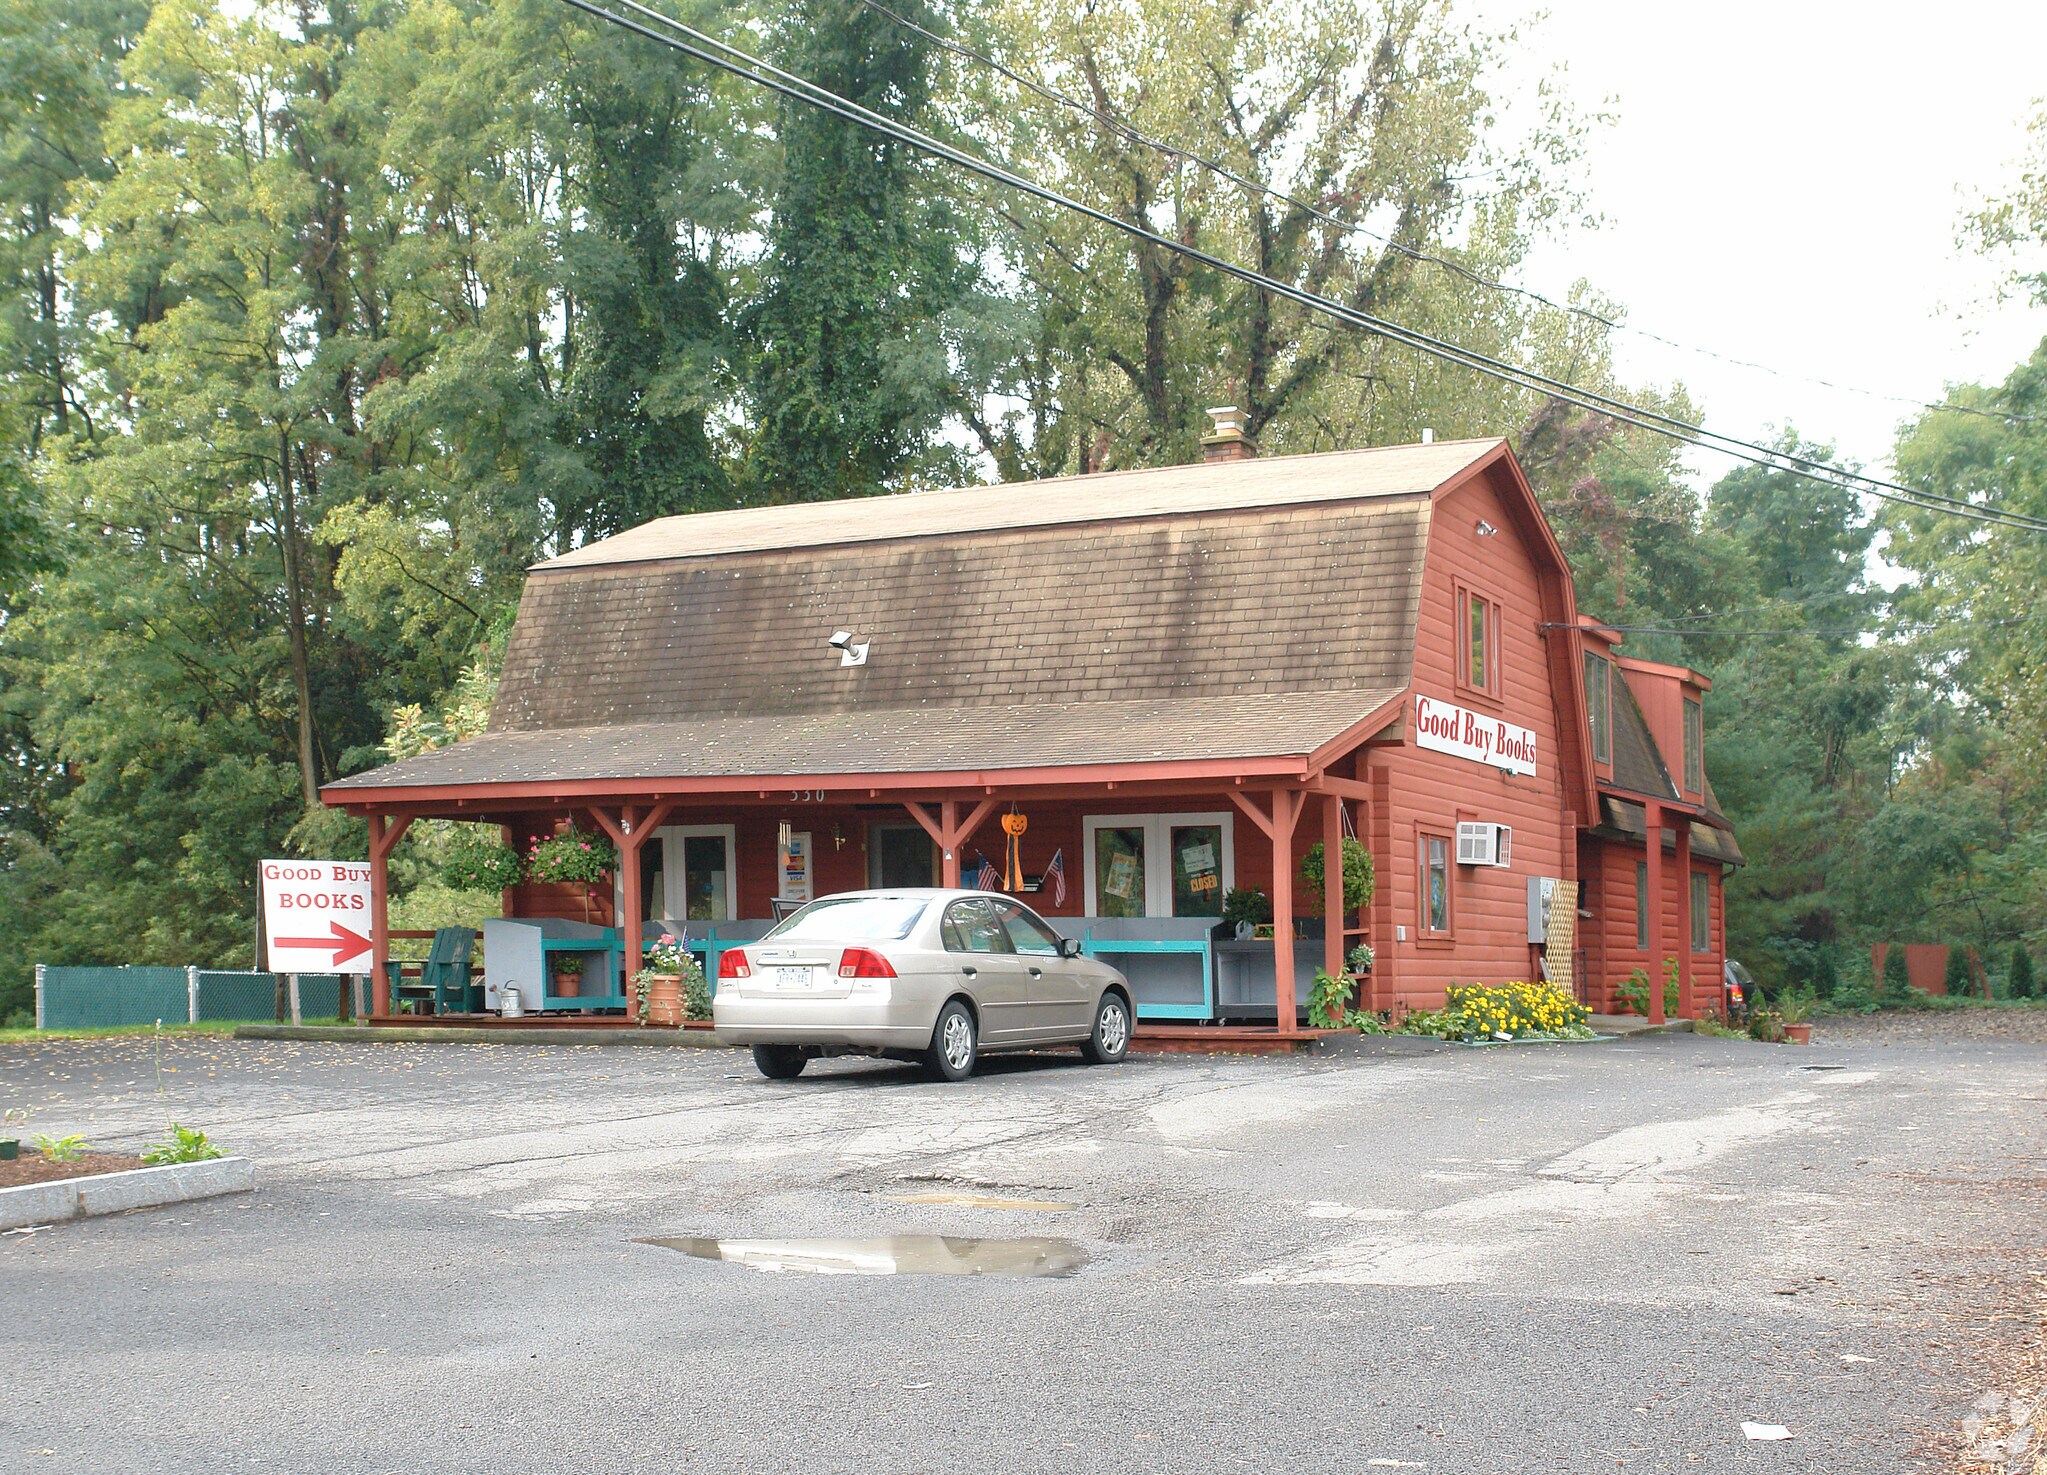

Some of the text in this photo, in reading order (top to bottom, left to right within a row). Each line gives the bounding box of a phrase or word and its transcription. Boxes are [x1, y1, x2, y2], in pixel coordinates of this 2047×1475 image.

[1417, 697, 1536, 764] Good Buy Books
[264, 865, 322, 880] GOOD
[1190, 874, 1218, 893] CLOSED
[278, 893, 365, 910] BOOKS
